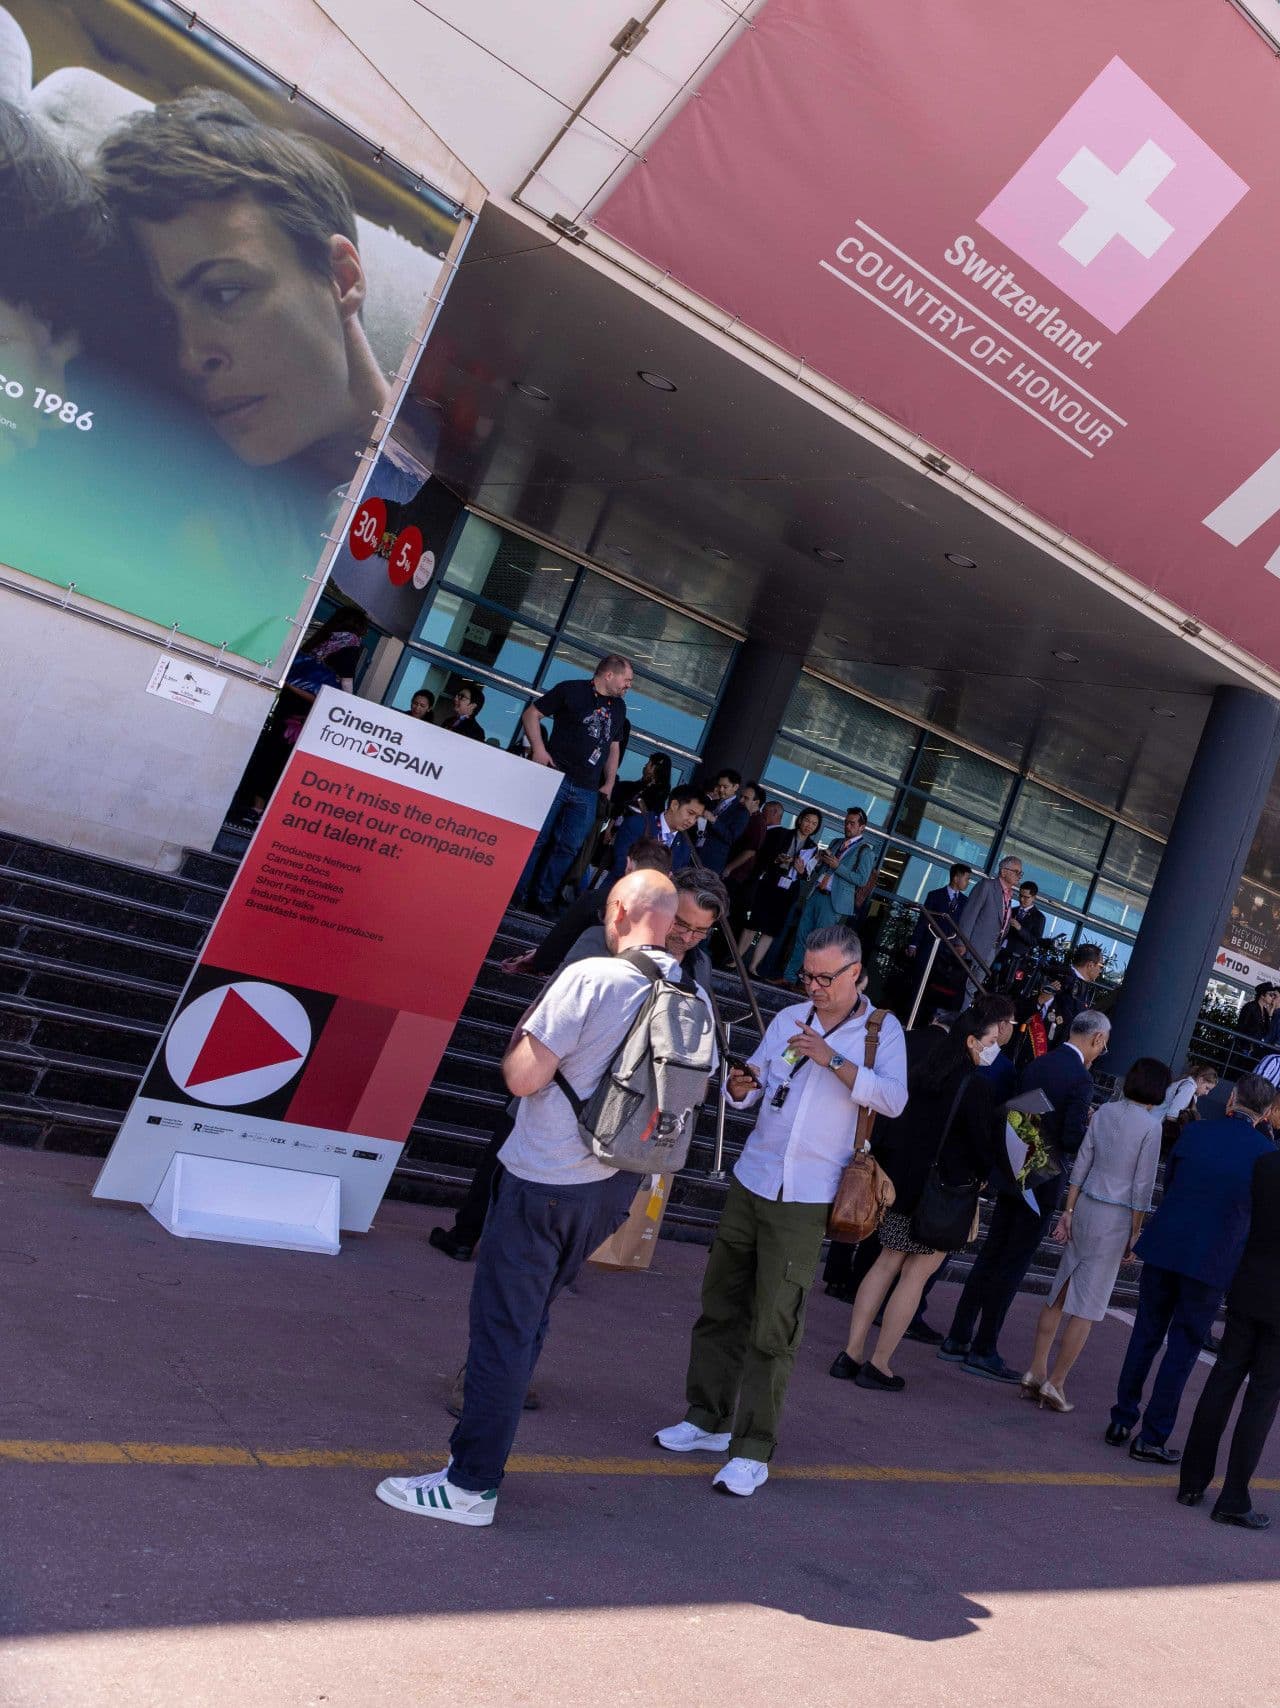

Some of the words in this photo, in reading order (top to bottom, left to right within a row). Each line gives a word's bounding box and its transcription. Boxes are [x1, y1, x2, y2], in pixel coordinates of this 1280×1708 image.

[944, 235, 1102, 370] Switzerland.
[835, 236, 976, 341] COUNTRY
[969, 335, 1013, 366] OF
[1006, 361, 1114, 448] HONOUR
[33, 387, 94, 431] 1986
[354, 510, 378, 548] 30%
[396, 542, 411, 572] 5%
[328, 706, 403, 745] Cinema
[320, 725, 363, 753] from
[380, 747, 443, 780] SPAIN
[282, 812, 321, 835] and
[323, 820, 378, 853] talent
[378, 842, 402, 860] at:
[291, 790, 312, 809] to
[314, 800, 364, 825] meet
[366, 815, 399, 835] our
[399, 826, 495, 867] companies
[356, 790, 400, 815] miss
[403, 804, 433, 826] the
[435, 817, 498, 847] chance
[266, 853, 304, 870] Cannes
[304, 864, 331, 878] Docs
[271, 841, 325, 862] Producers
[322, 855, 362, 874] Network
[251, 887, 290, 905] Industry
[256, 876, 286, 890] Short
[284, 884, 305, 896] Film
[306, 890, 340, 905] Corner
[261, 864, 299, 882] Cannes
[299, 875, 344, 894] Remakes
[244, 898, 298, 920] Breakfasts
[299, 912, 319, 925] with
[320, 919, 337, 929] our
[336, 922, 384, 942] producers
[1231, 936, 1242, 947] BE
[1244, 941, 1263, 955] DUST
